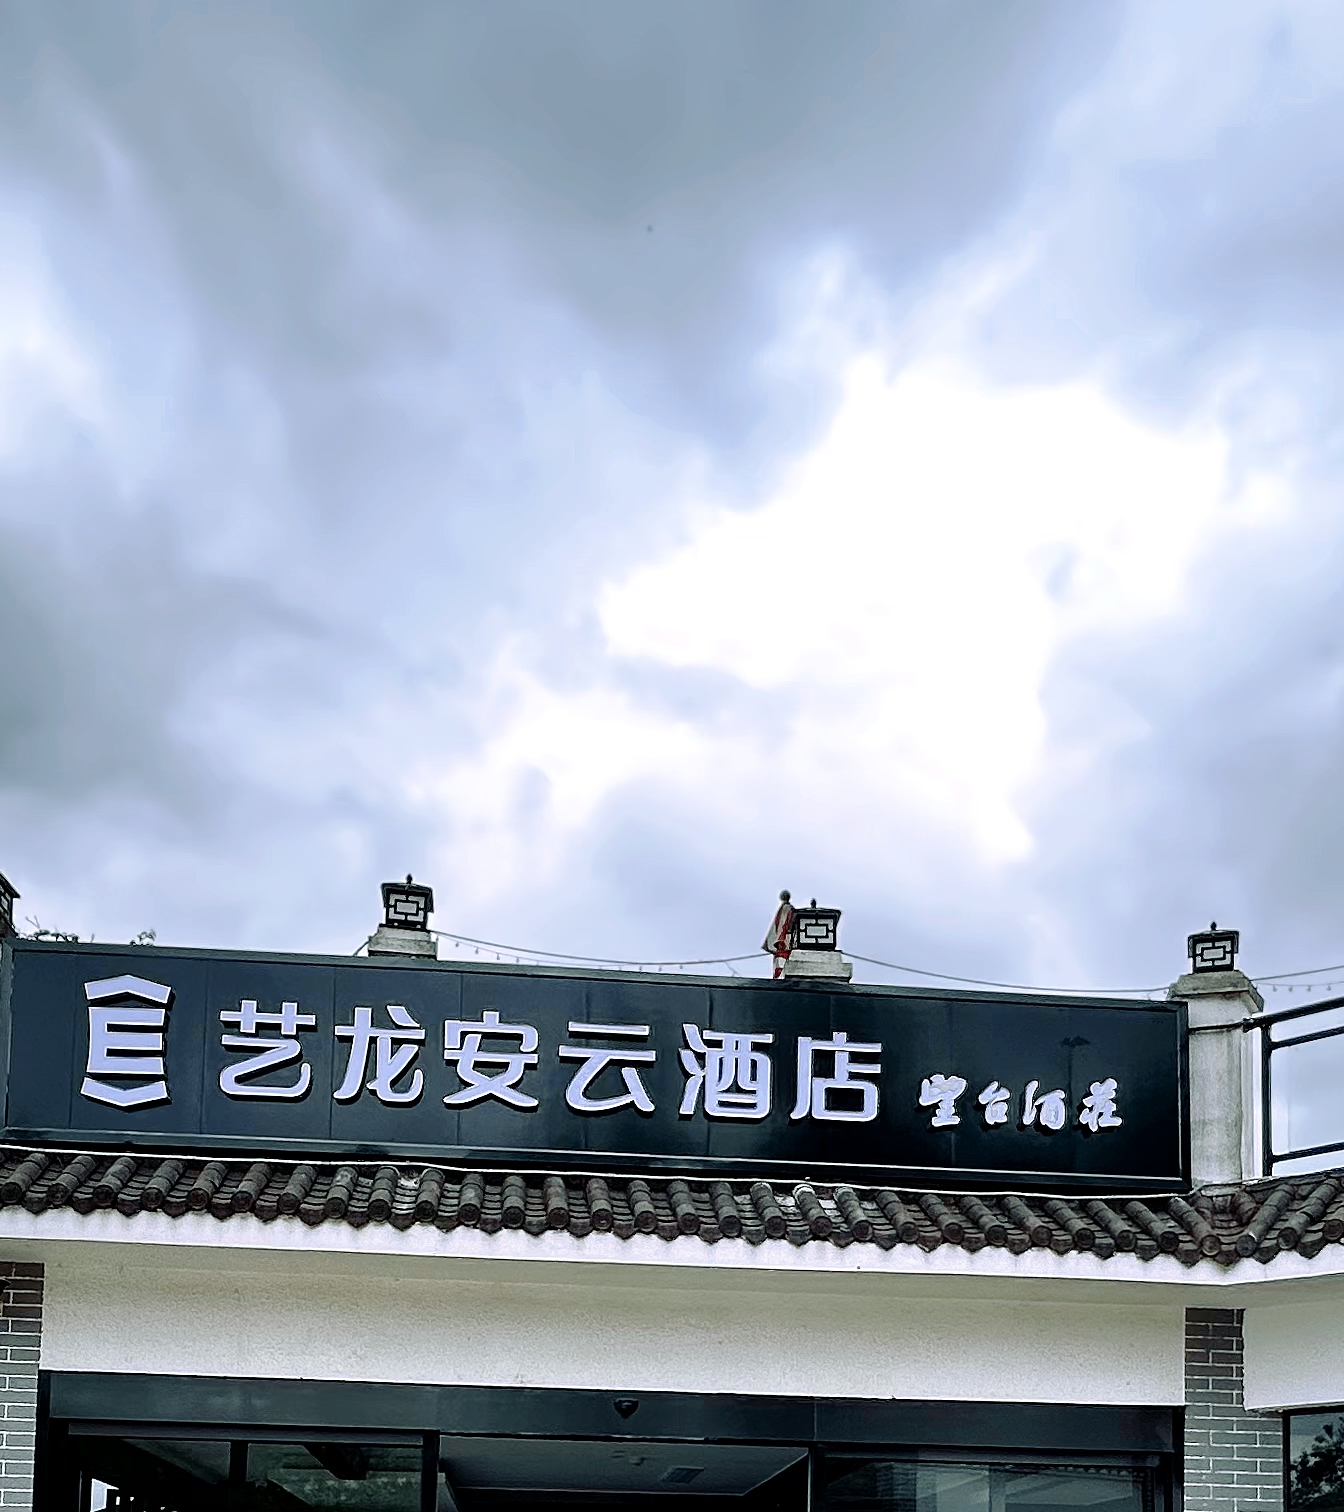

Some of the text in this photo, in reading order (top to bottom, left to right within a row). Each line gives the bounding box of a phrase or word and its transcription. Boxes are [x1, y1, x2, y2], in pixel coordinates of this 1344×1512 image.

[219, 1000, 882, 1122] 艺龙安云酒店
